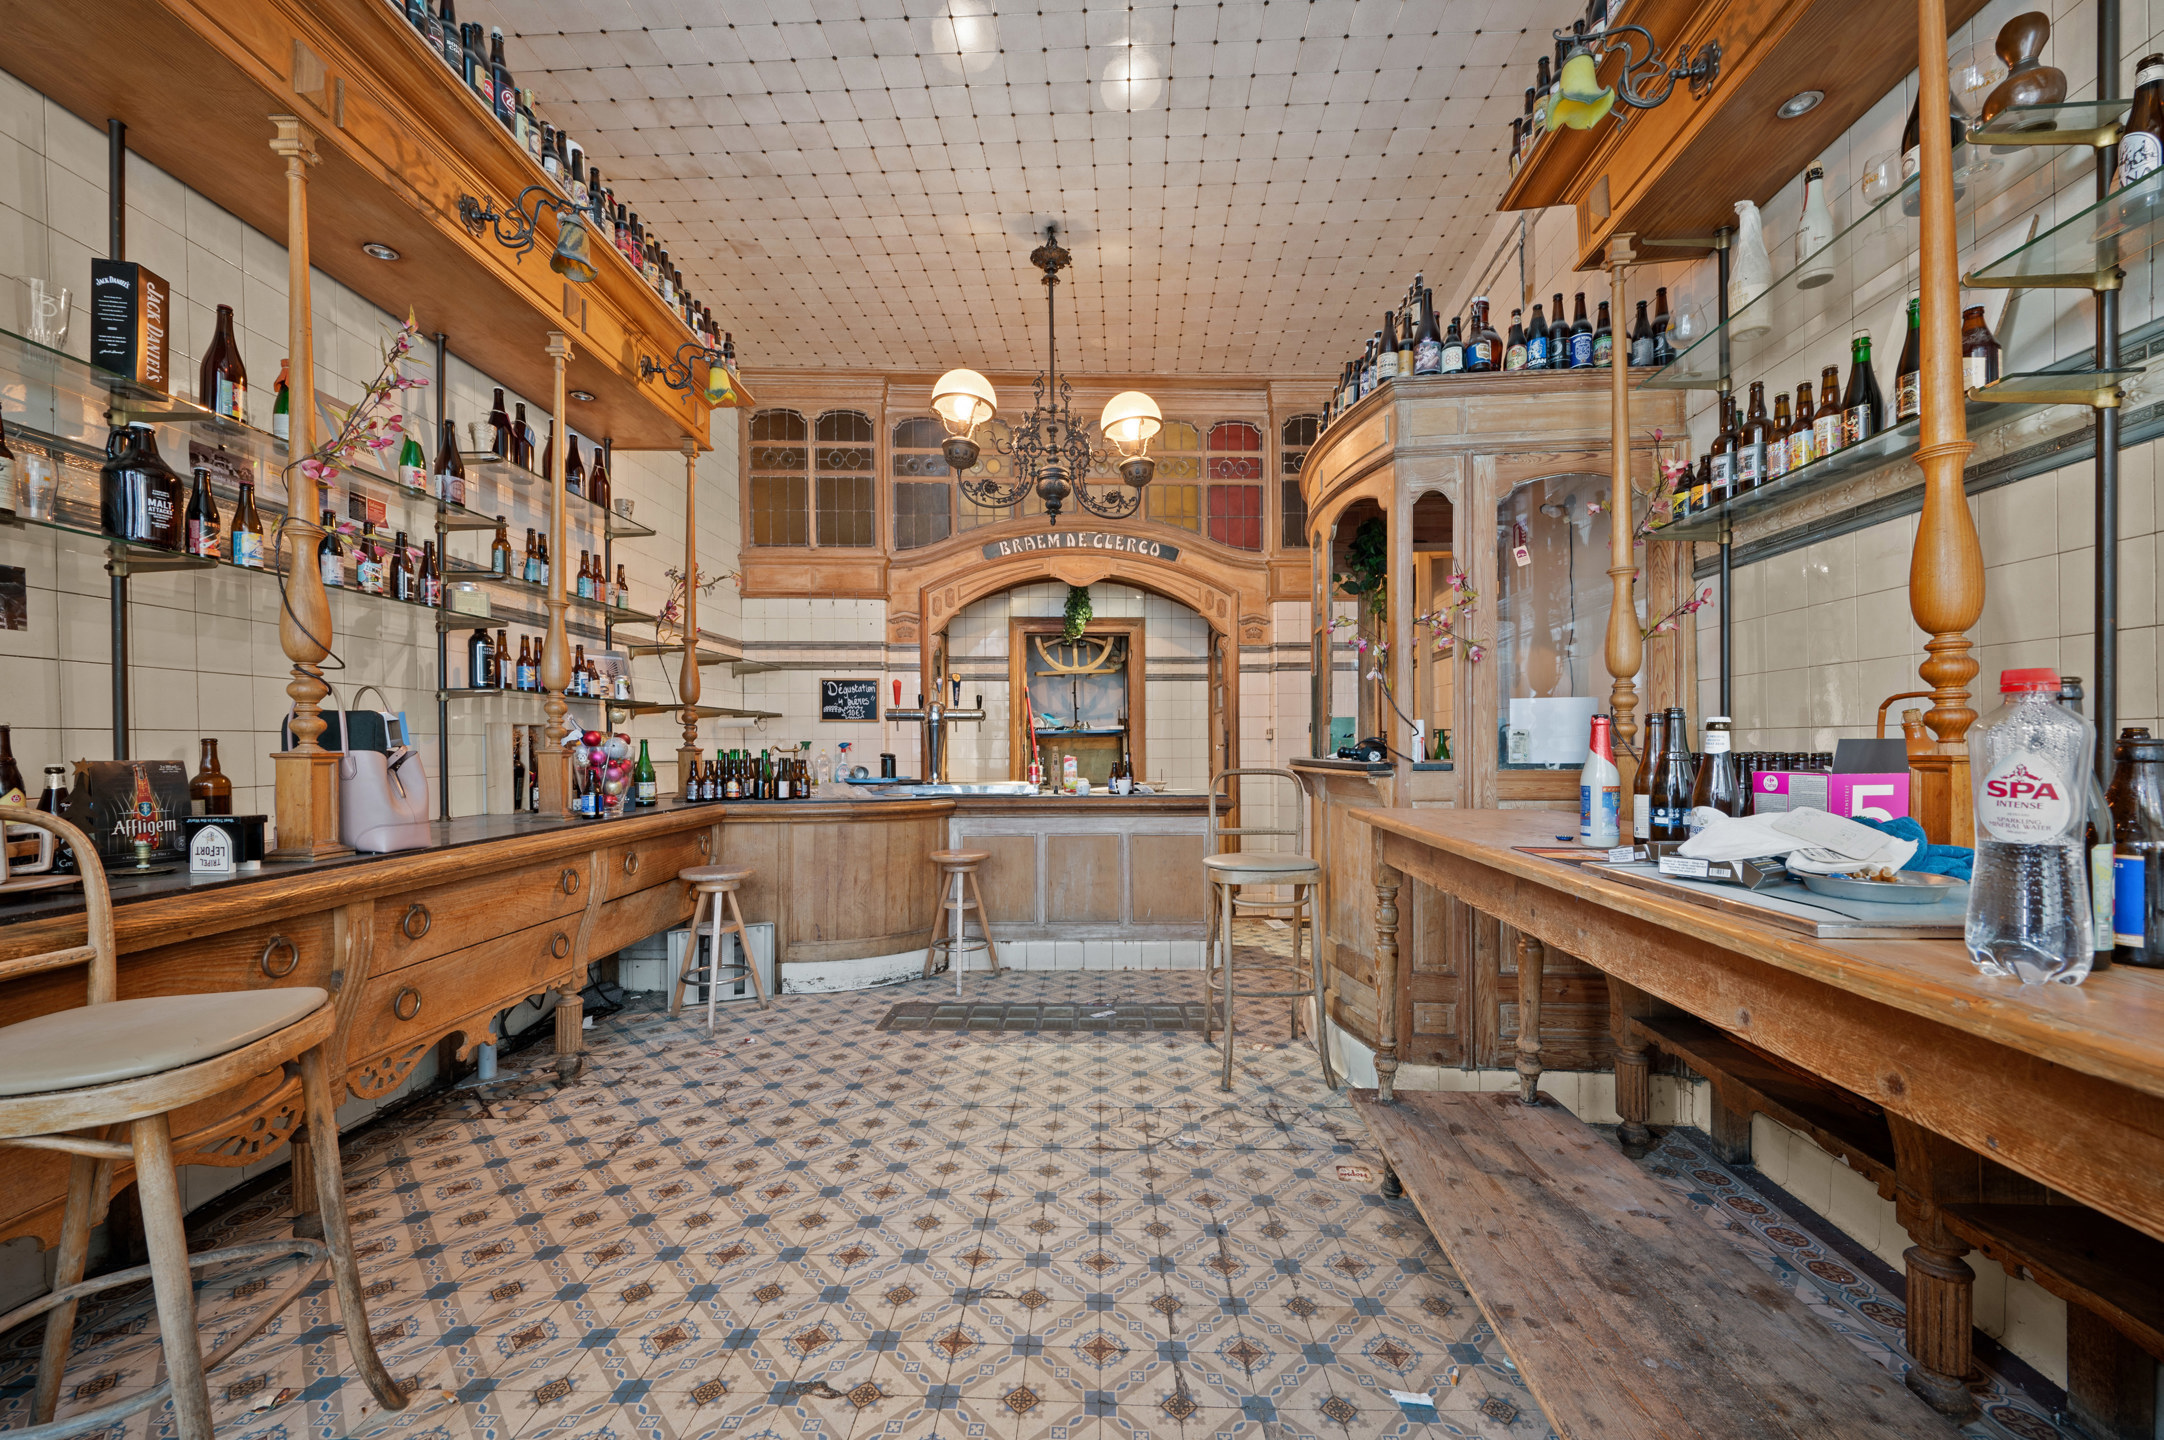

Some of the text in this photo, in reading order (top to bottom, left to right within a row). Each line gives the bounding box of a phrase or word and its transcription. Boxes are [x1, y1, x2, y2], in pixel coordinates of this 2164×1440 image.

[146, 281, 164, 383] JACK DANIEL'S
[999, 532, 1060, 556] BRAEM
[1066, 532, 1087, 548] DE
[1986, 779, 2060, 801] SPA
[1851, 784, 1894, 823] 5
[1996, 799, 2044, 810] INTENSE
[111, 819, 177, 838] Affligem
[1988, 820, 2020, 830] MINERAL
[2023, 823, 2052, 832] WATER
[1996, 816, 2042, 825] SPARKLING
[200, 858, 221, 867] TRIPEL
